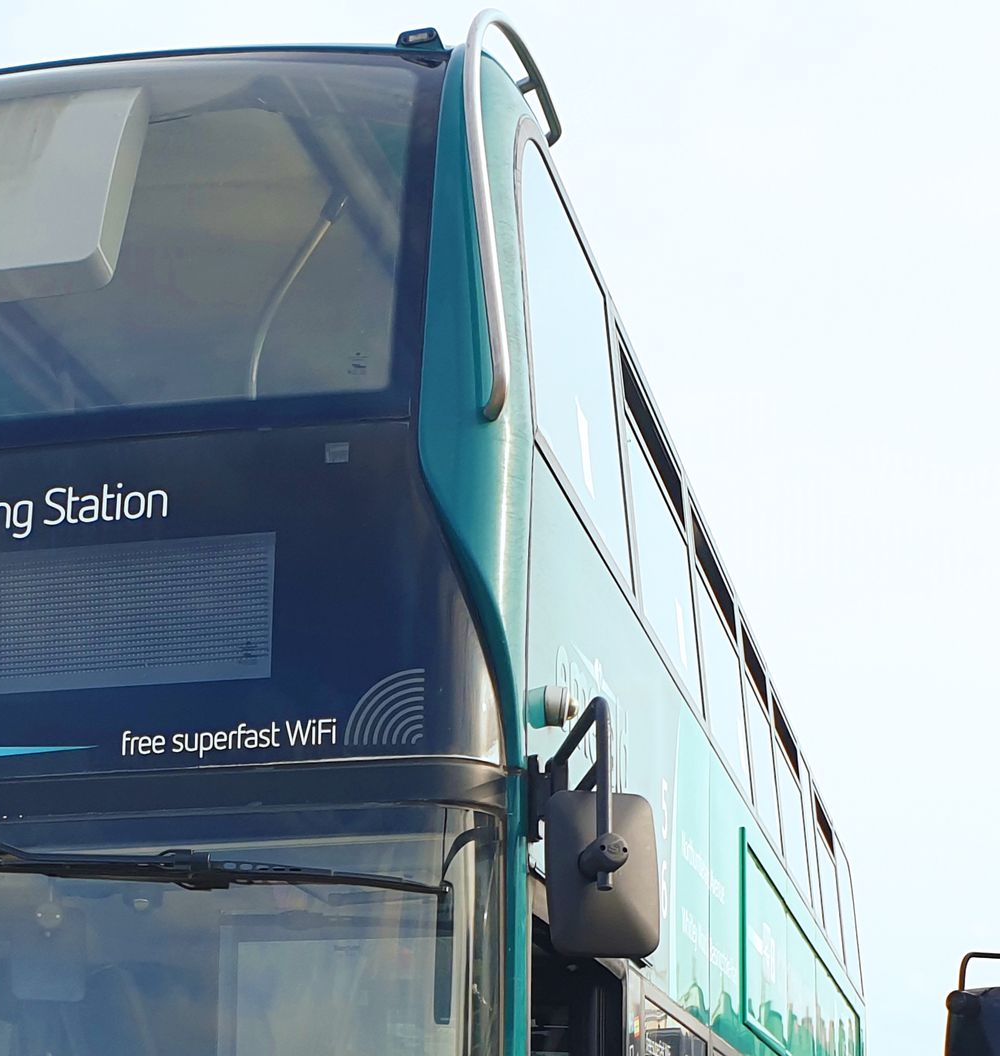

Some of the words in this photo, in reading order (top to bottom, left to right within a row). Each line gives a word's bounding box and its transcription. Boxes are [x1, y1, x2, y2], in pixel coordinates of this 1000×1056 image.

[44, 483, 169, 527] Station
[121, 729, 165, 757] free
[172, 722, 280, 758] superfast
[285, 717, 337, 746] WiFi
